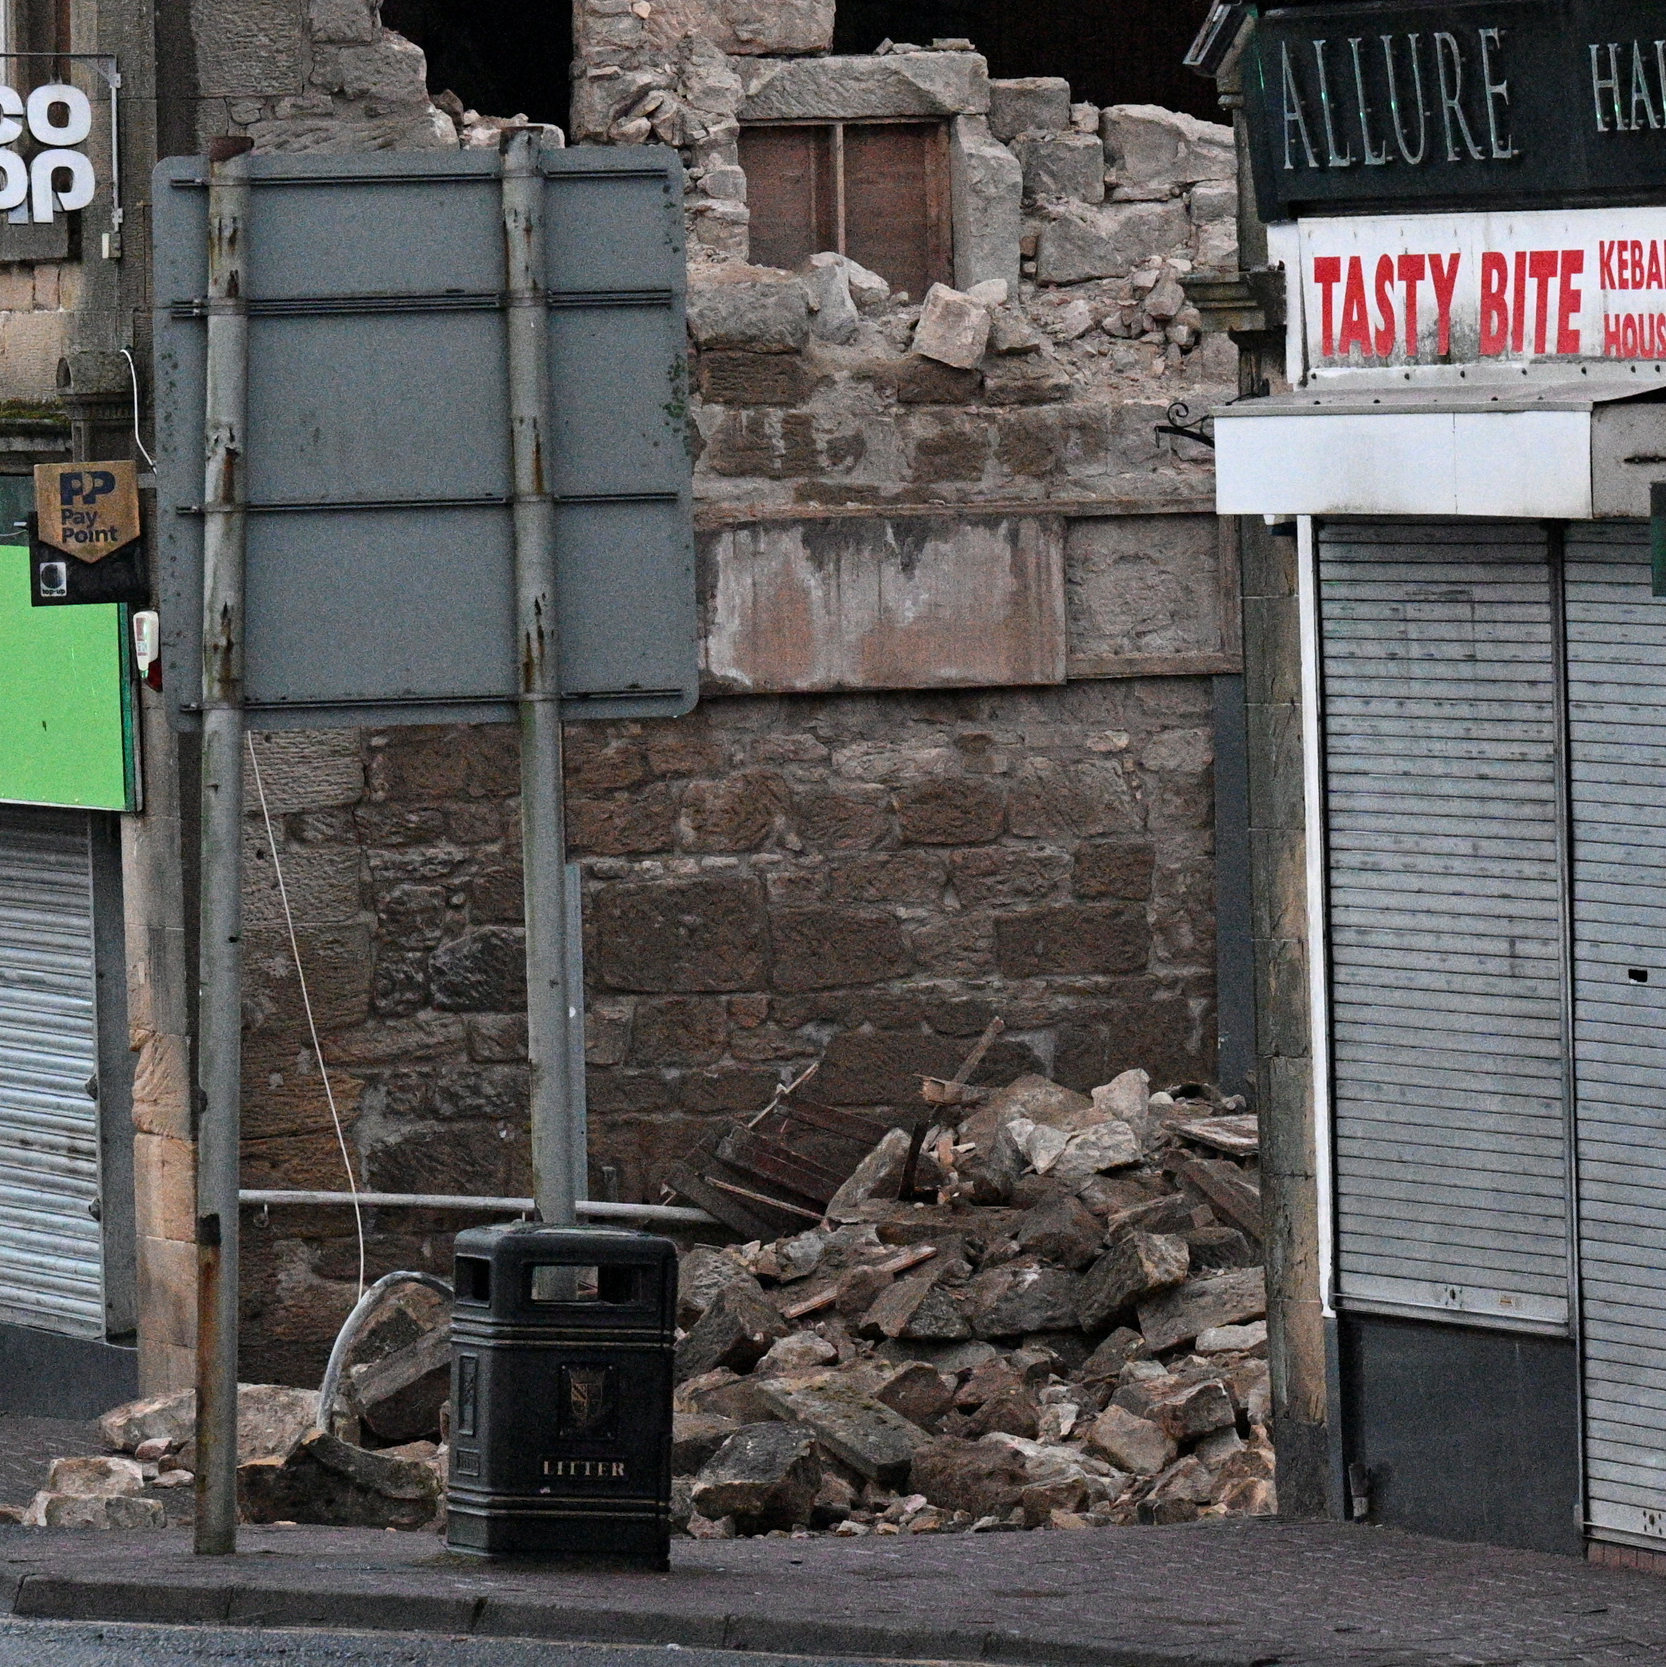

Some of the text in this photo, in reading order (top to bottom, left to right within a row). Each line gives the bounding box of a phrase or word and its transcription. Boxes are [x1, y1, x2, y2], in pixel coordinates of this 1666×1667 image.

[1281, 27, 1514, 170] ALLURE
[1313, 249, 1585, 357] TASTY BITE
[61, 508, 99, 529] Pay
[61, 525, 119, 544] Point
[542, 1460, 626, 1477] LITTER
